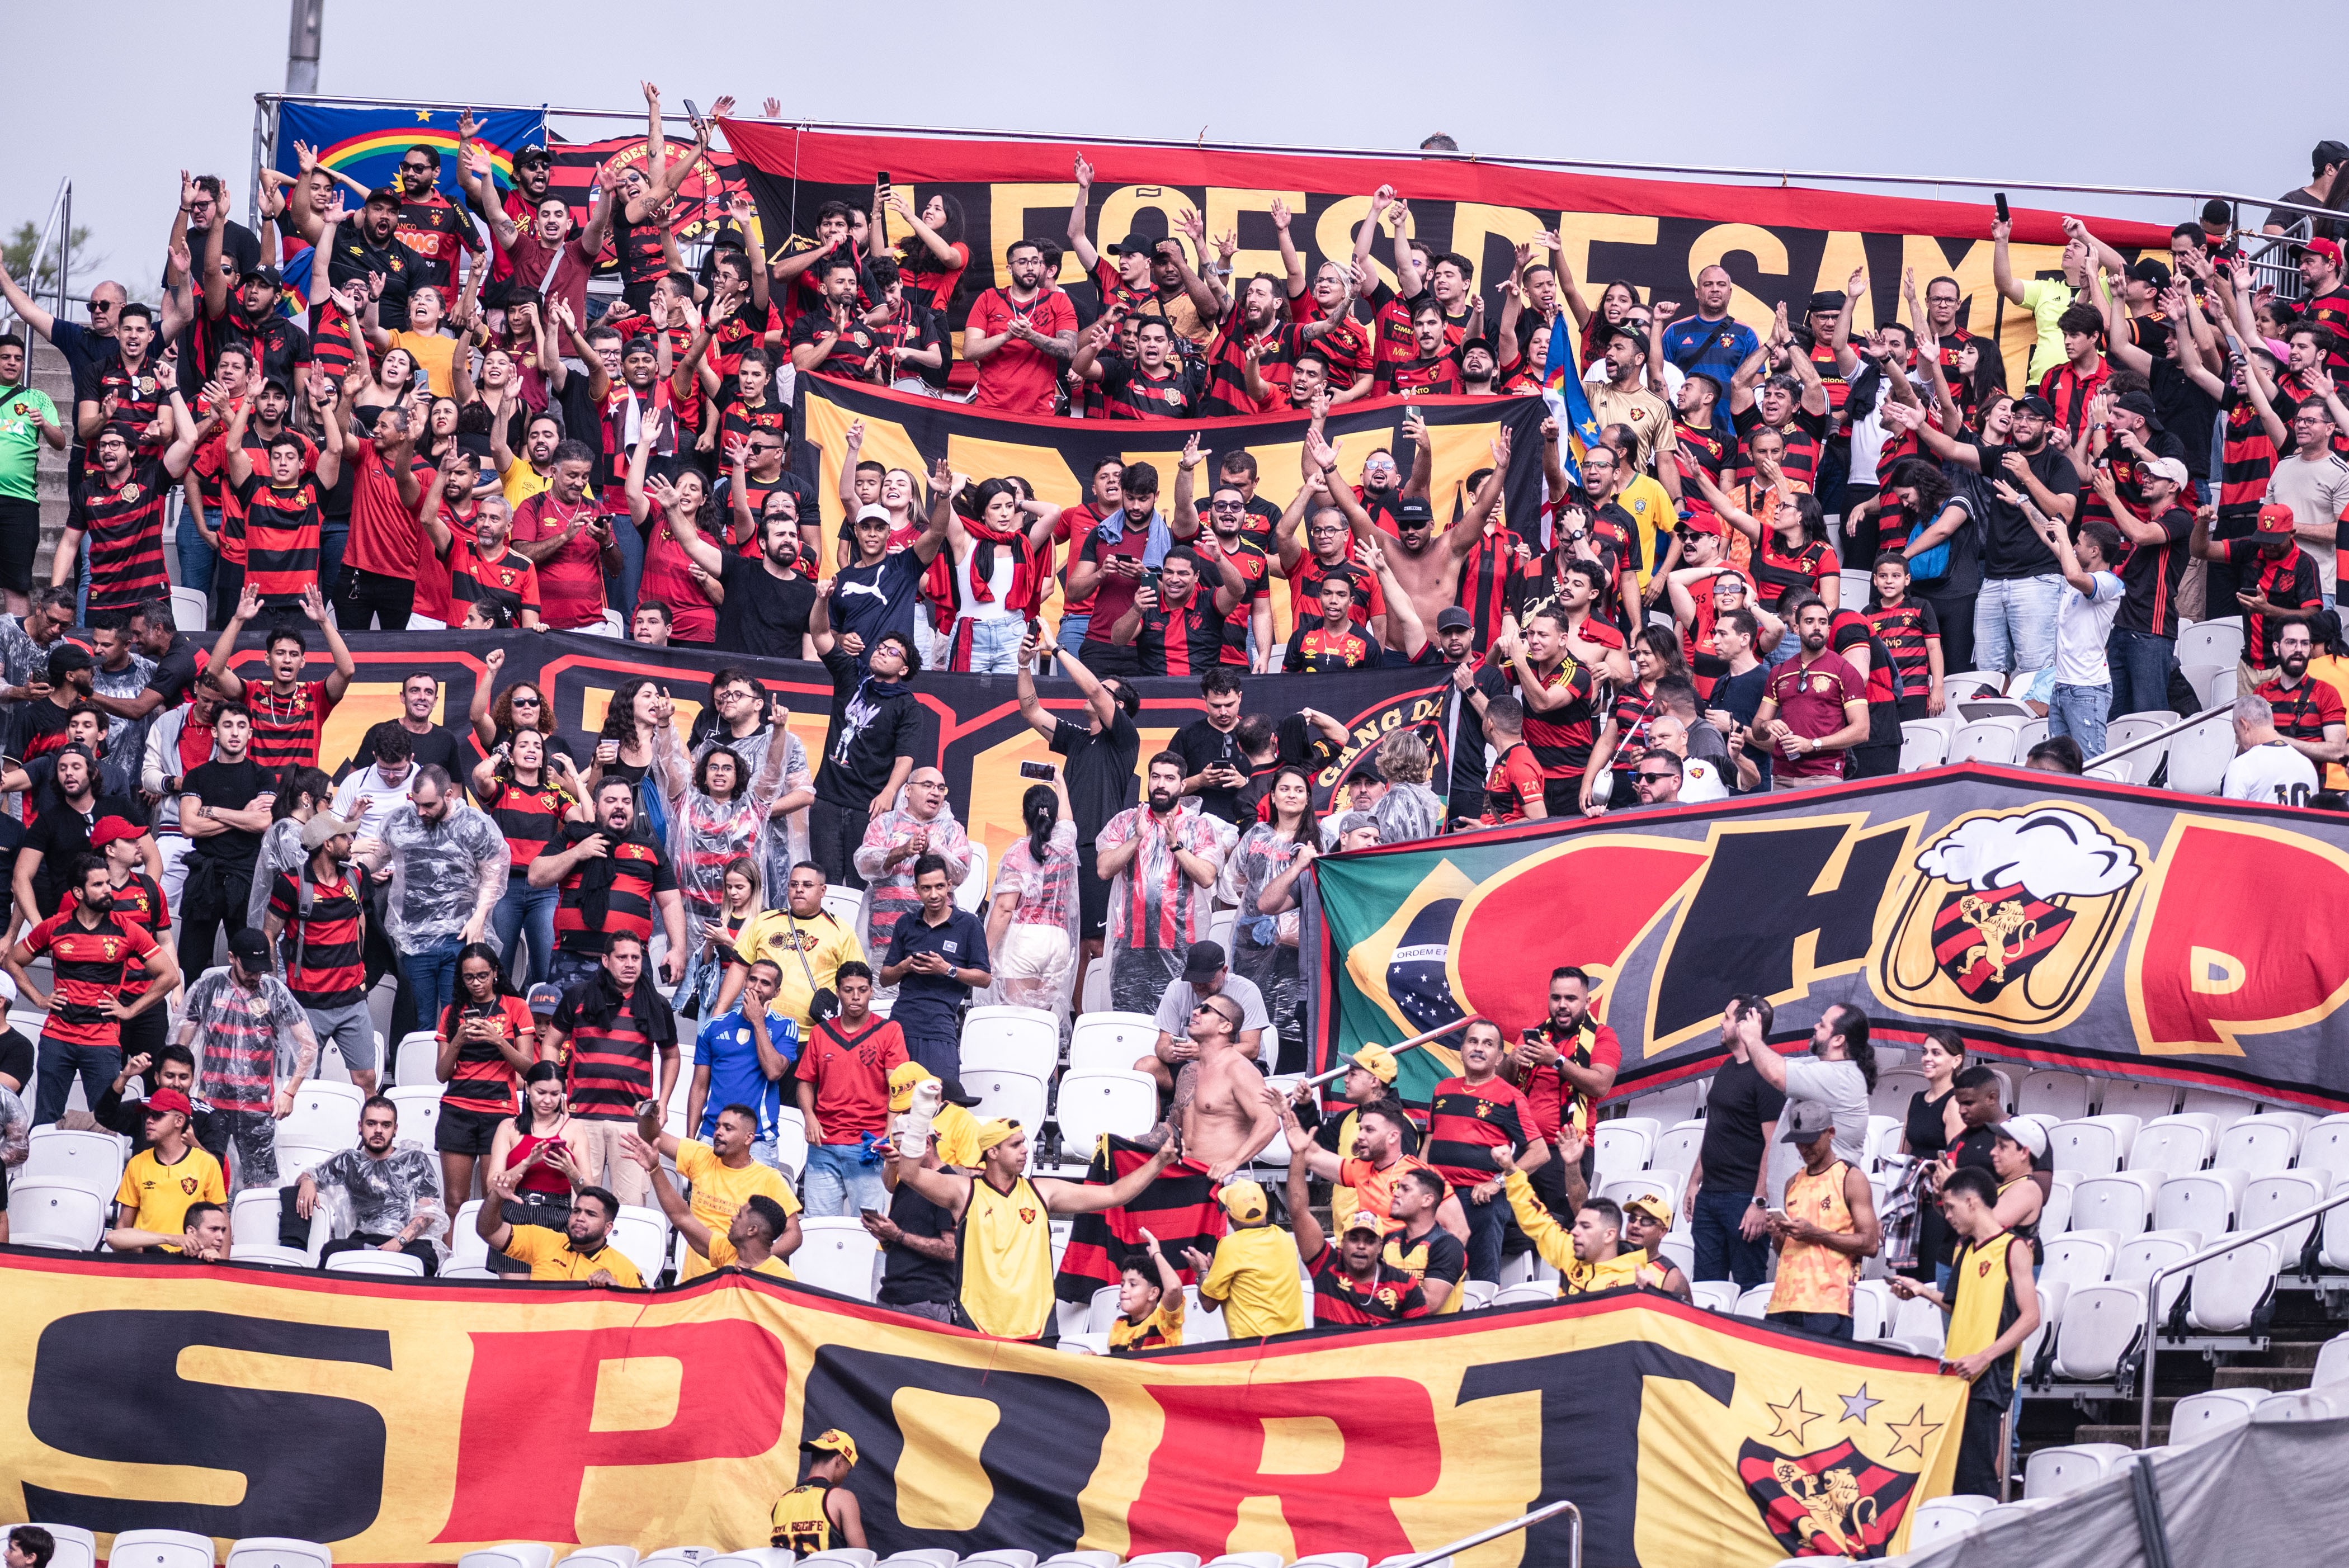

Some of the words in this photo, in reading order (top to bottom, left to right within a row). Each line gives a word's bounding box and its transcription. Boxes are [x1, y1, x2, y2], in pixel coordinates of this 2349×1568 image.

[605, 144, 647, 173] EÕES
[678, 149, 717, 186] SMPA
[1451, 201, 1659, 369] DE
[1688, 223, 2173, 398] SAMP
[1318, 708, 1402, 787] GANG
[1411, 696, 1444, 721] DA
[1397, 949, 1433, 958] ORDEM
[21, 1307, 1735, 1568] SPORT
[791, 1520, 824, 1532] RECIFE
